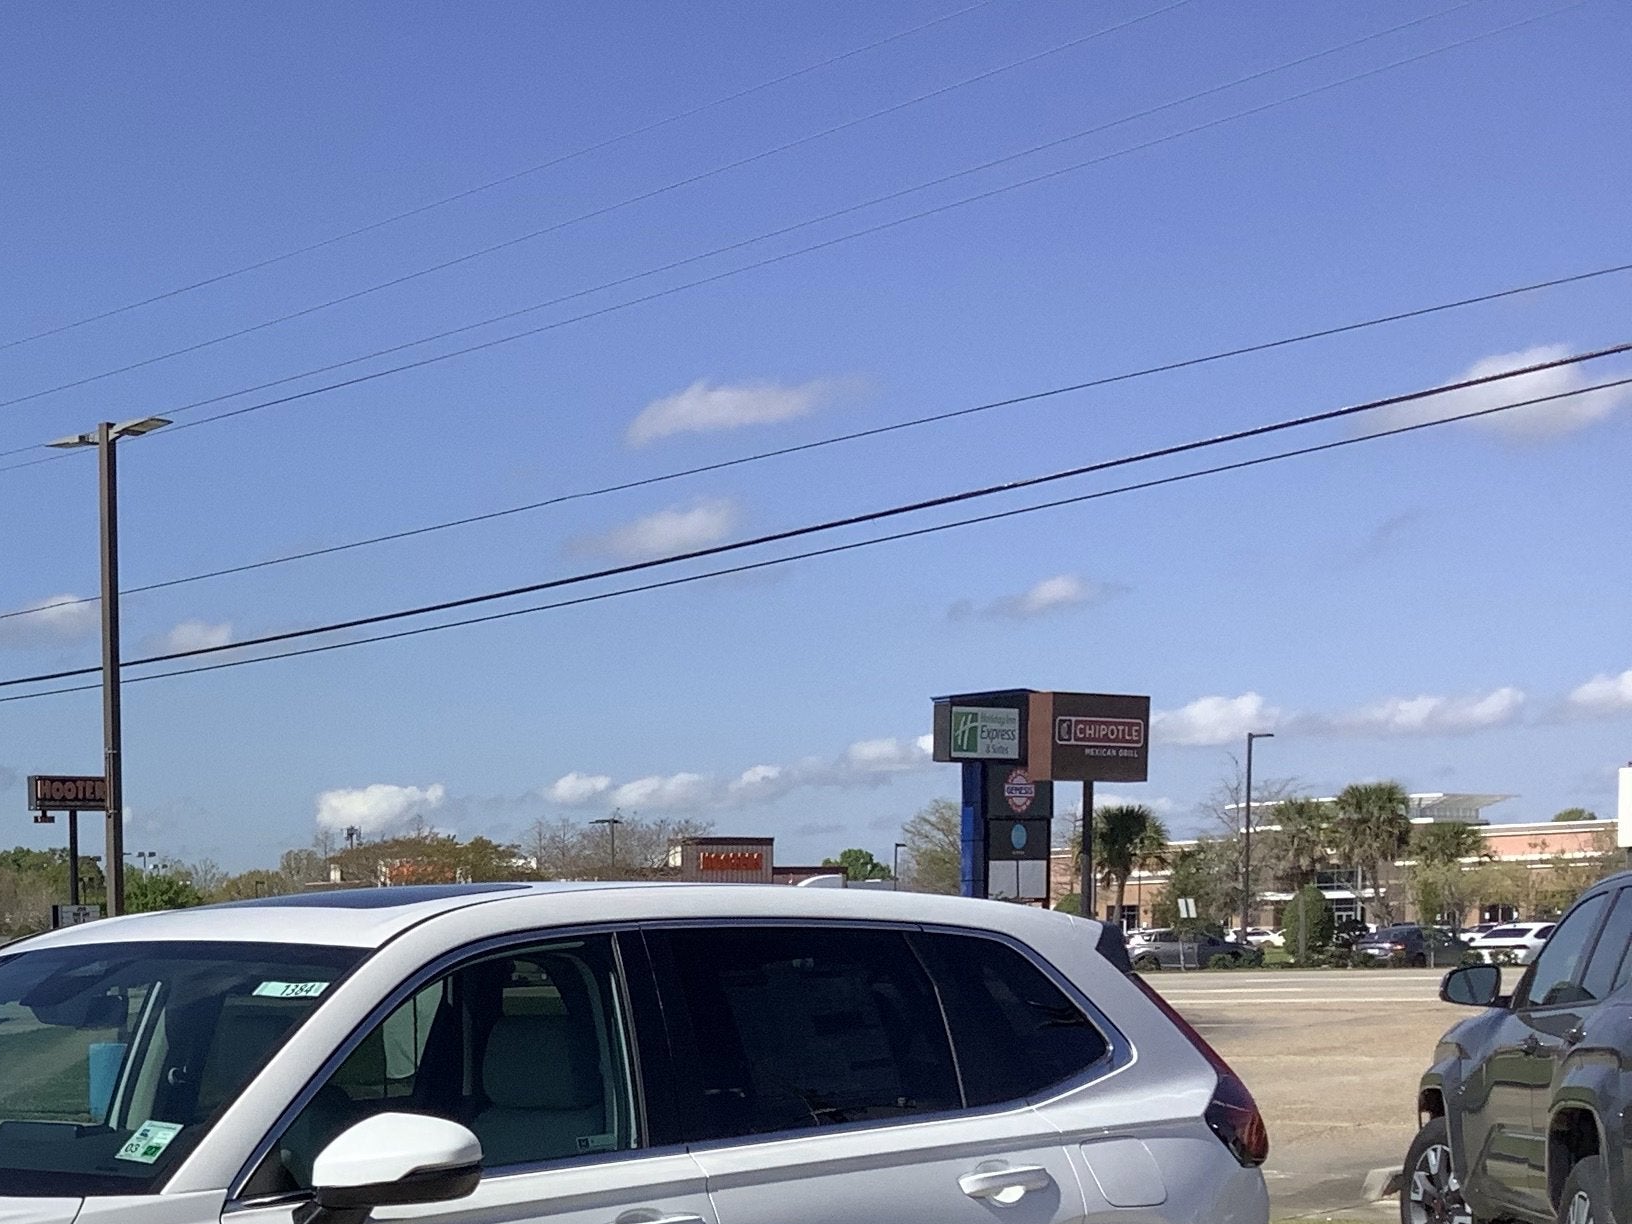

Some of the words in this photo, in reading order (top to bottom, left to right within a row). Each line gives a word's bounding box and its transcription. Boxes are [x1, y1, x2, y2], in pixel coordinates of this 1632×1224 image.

[980, 724, 1017, 743] Express
[1075, 723, 1141, 741] CHIPOTLE
[1084, 748, 1117, 757] MEXICAN
[1118, 749, 1139, 758] GRILL
[37, 779, 106, 800] HOOTER
[280, 983, 317, 996] 1384
